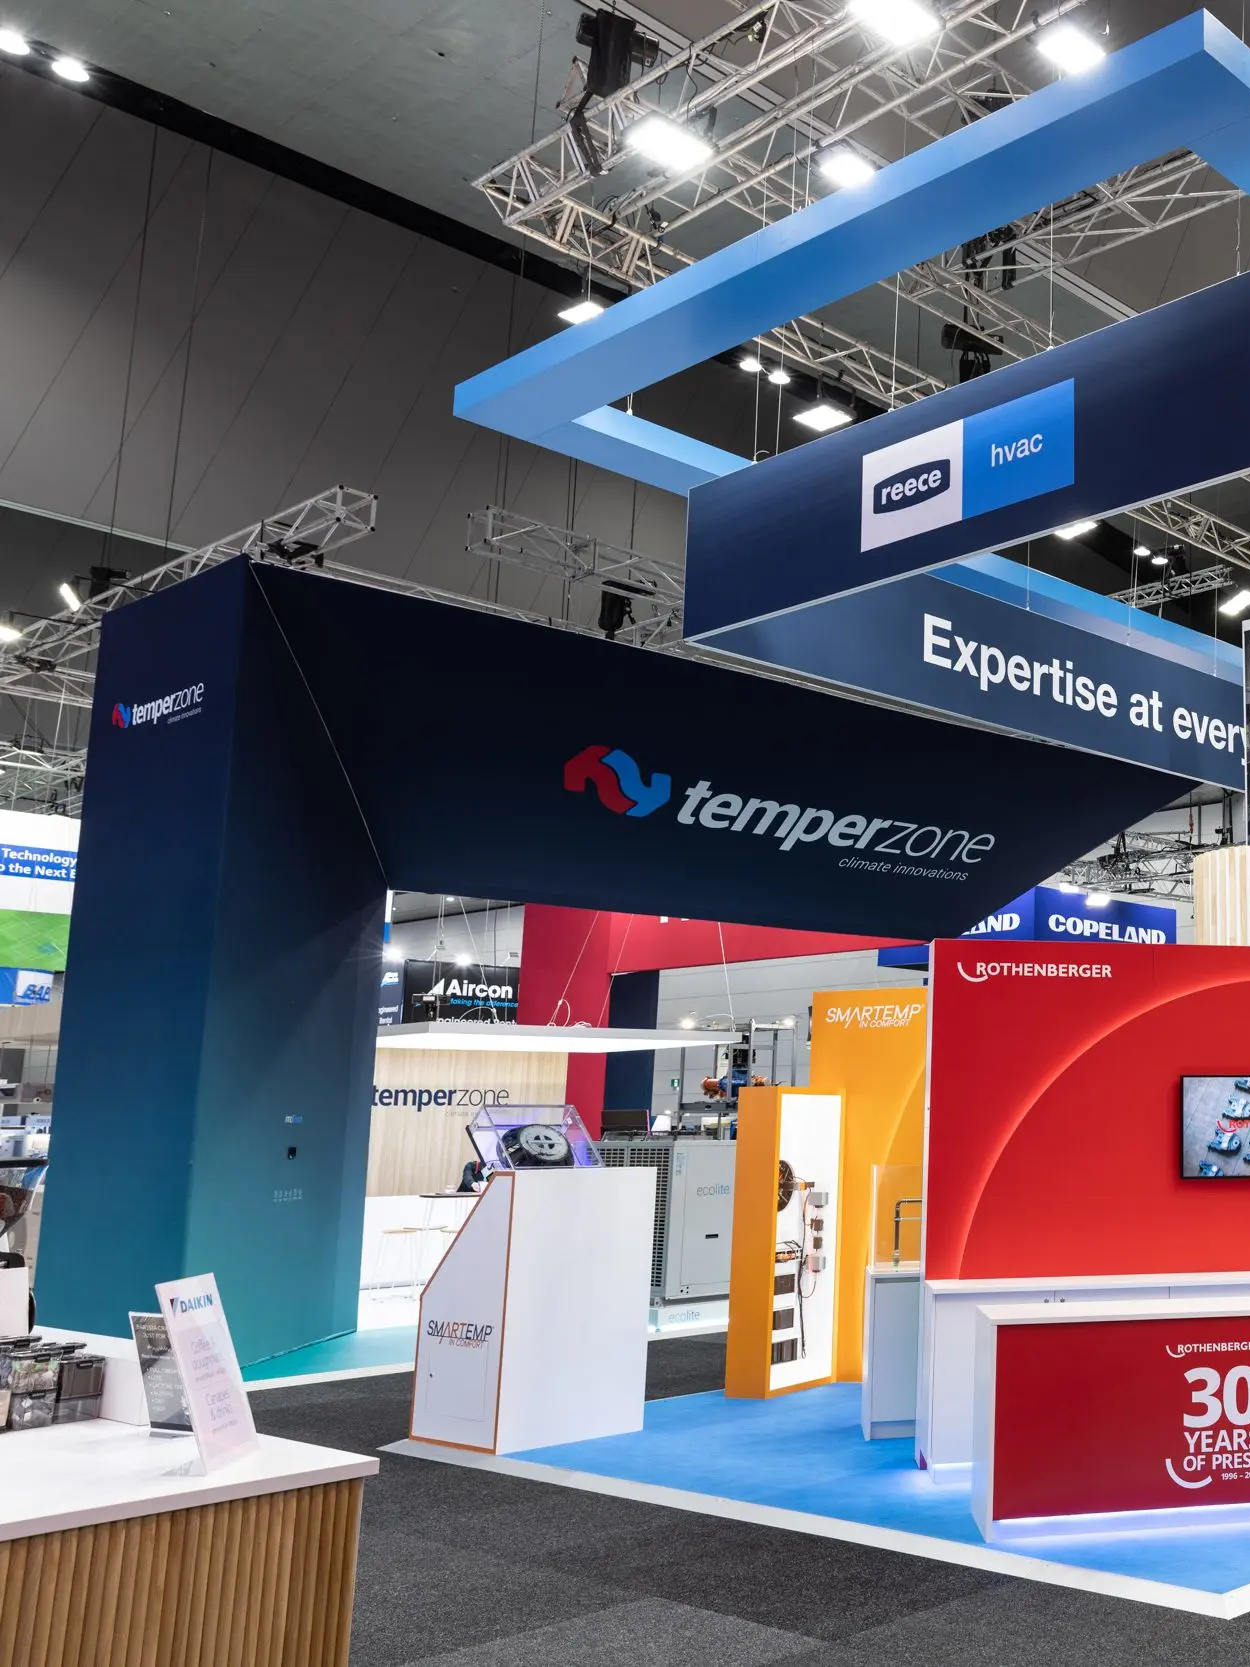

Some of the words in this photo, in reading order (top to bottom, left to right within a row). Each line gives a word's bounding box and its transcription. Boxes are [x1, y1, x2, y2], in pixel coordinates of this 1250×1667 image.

[880, 468, 942, 505] reece
[990, 432, 1043, 468] hvac
[923, 613, 1117, 718] Expertise
[1129, 691, 1163, 732] at
[132, 682, 205, 725] temperzone
[677, 780, 995, 864] temperzone
[2, 847, 78, 868] Technology
[8, 863, 31, 874] the
[35, 865, 68, 878] Next
[838, 856, 891, 874] climate
[893, 862, 969, 882] innovations
[1048, 913, 1167, 944] COPELAND
[976, 962, 1113, 978] ROTHENBERGER
[446, 979, 513, 999] Aircon
[825, 1004, 925, 1029] SMARTEMP
[859, 1020, 869, 1029] IN
[870, 1018, 910, 1029] COMFORT
[371, 1085, 510, 1112] temperzone
[696, 1184, 730, 1197] ecolite
[180, 1293, 214, 1313] DAIKIN
[668, 1310, 701, 1323] ecolite
[427, 1320, 493, 1344] SMARTEMP
[1183, 1455, 1206, 1471] OF
[1221, 1472, 1237, 1480] 1996
